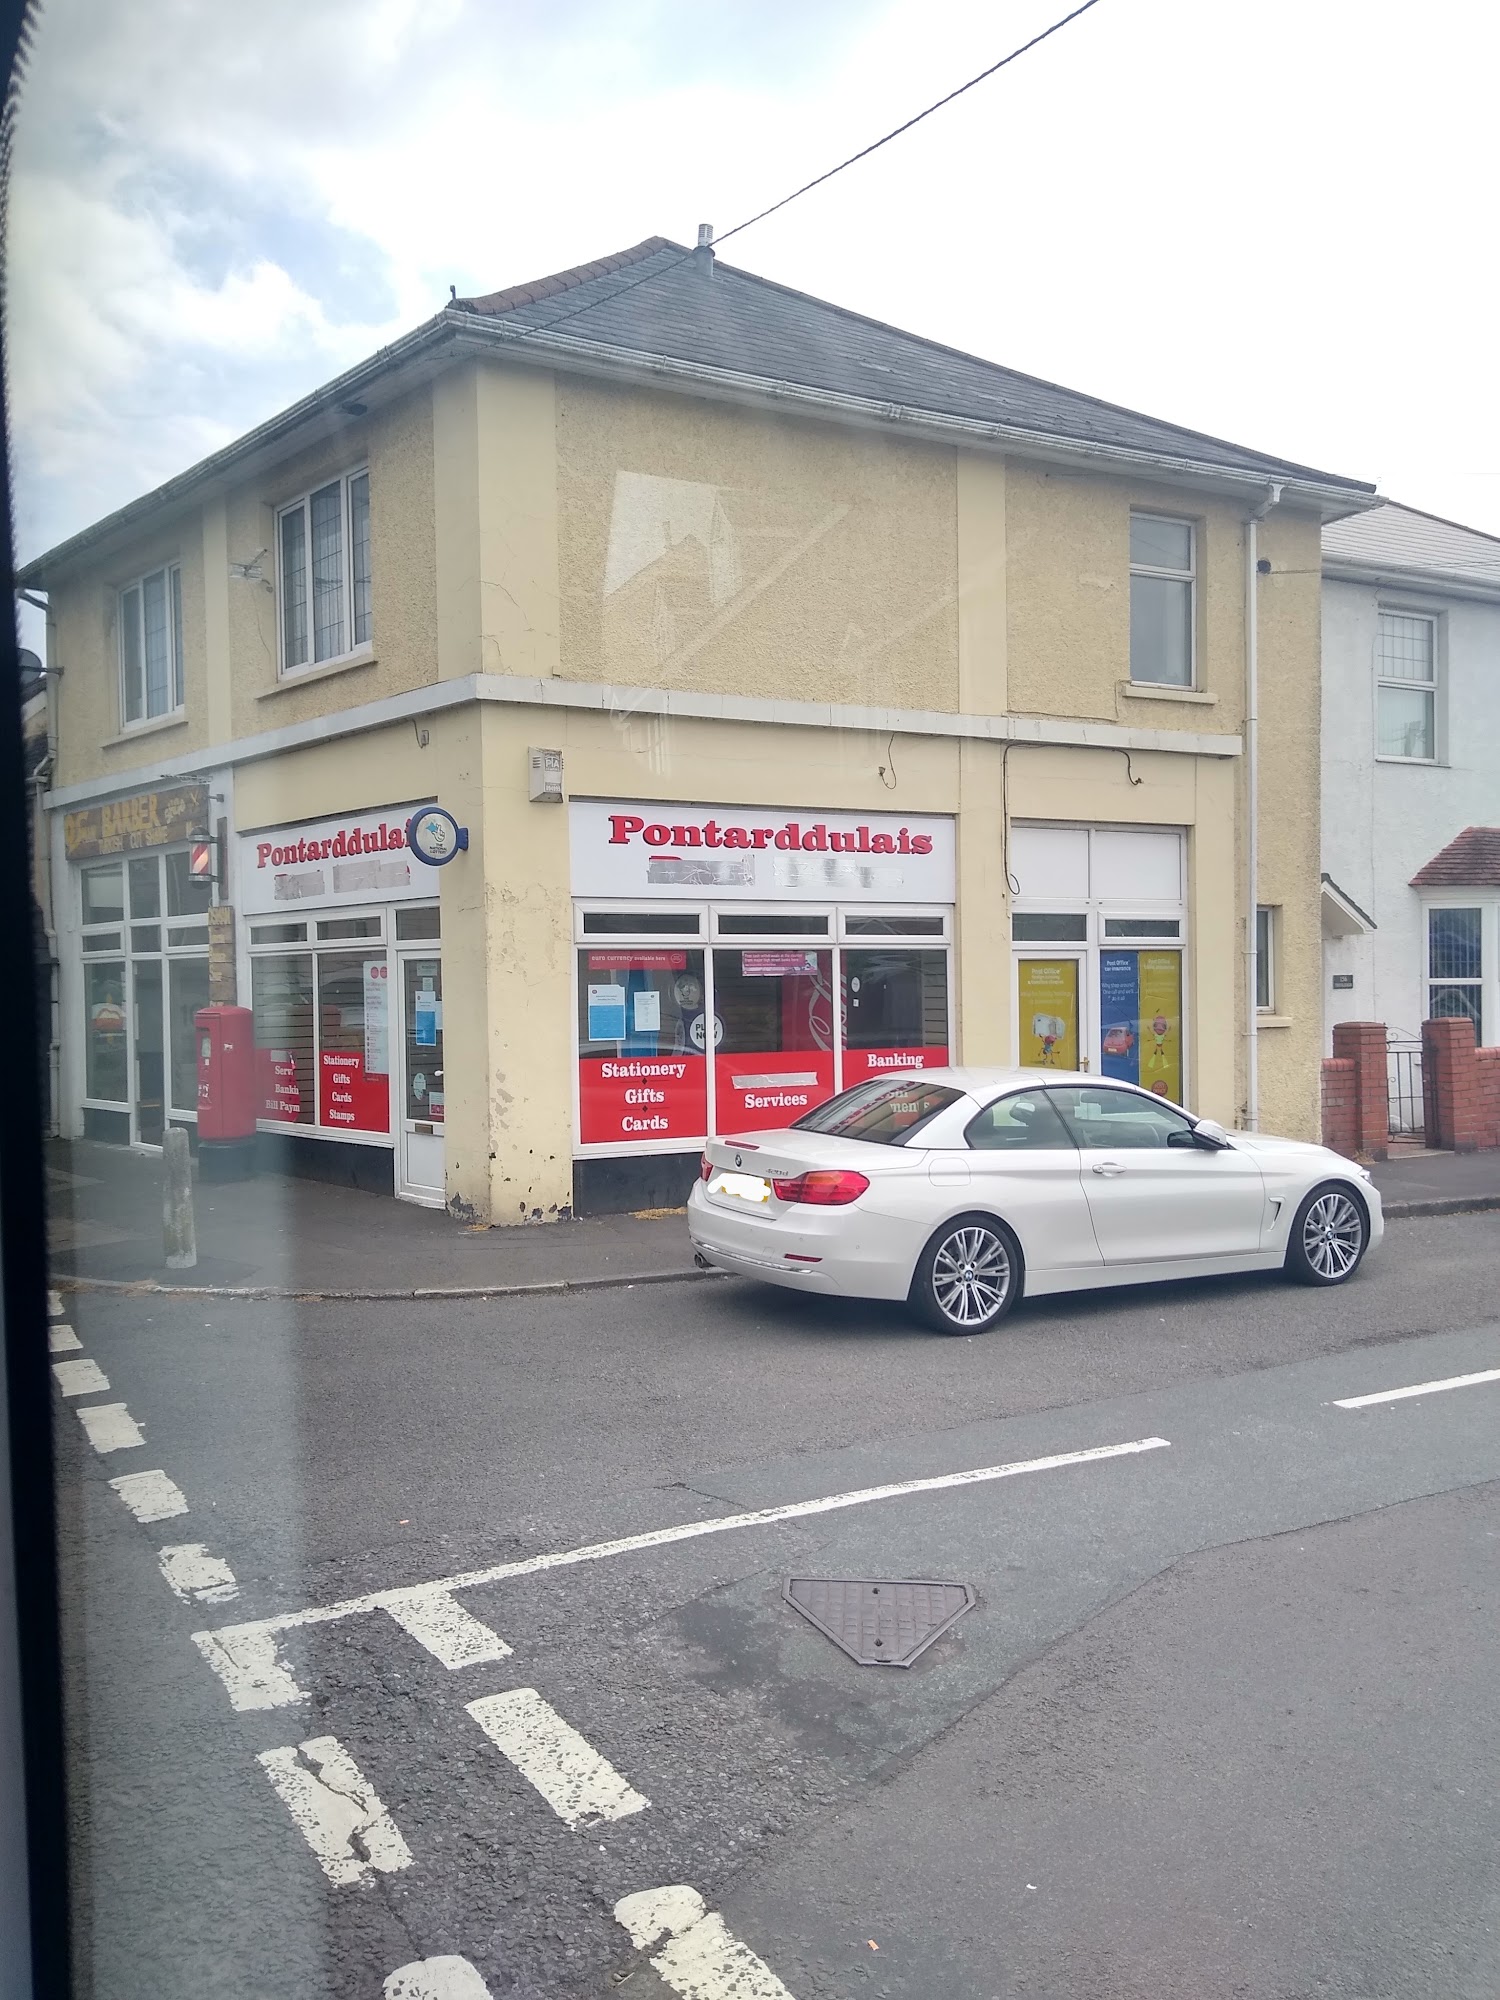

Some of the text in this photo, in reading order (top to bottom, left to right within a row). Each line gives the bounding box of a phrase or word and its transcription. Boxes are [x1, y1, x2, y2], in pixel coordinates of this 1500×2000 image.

[101, 794, 161, 839] BARBER
[256, 818, 411, 869] Pontarddulai
[608, 815, 934, 855] Pontarddulais
[323, 1055, 360, 1069] Stationery
[867, 1053, 924, 1068] Banking
[333, 1073, 350, 1084] Gifts
[601, 1062, 687, 1079] Stationery
[265, 1100, 279, 1110] Bill
[332, 1091, 352, 1103] Cards
[625, 1088, 665, 1105] Gifts
[744, 1092, 808, 1109] Services
[329, 1109, 355, 1123] Stamps
[621, 1115, 669, 1132] Cards
